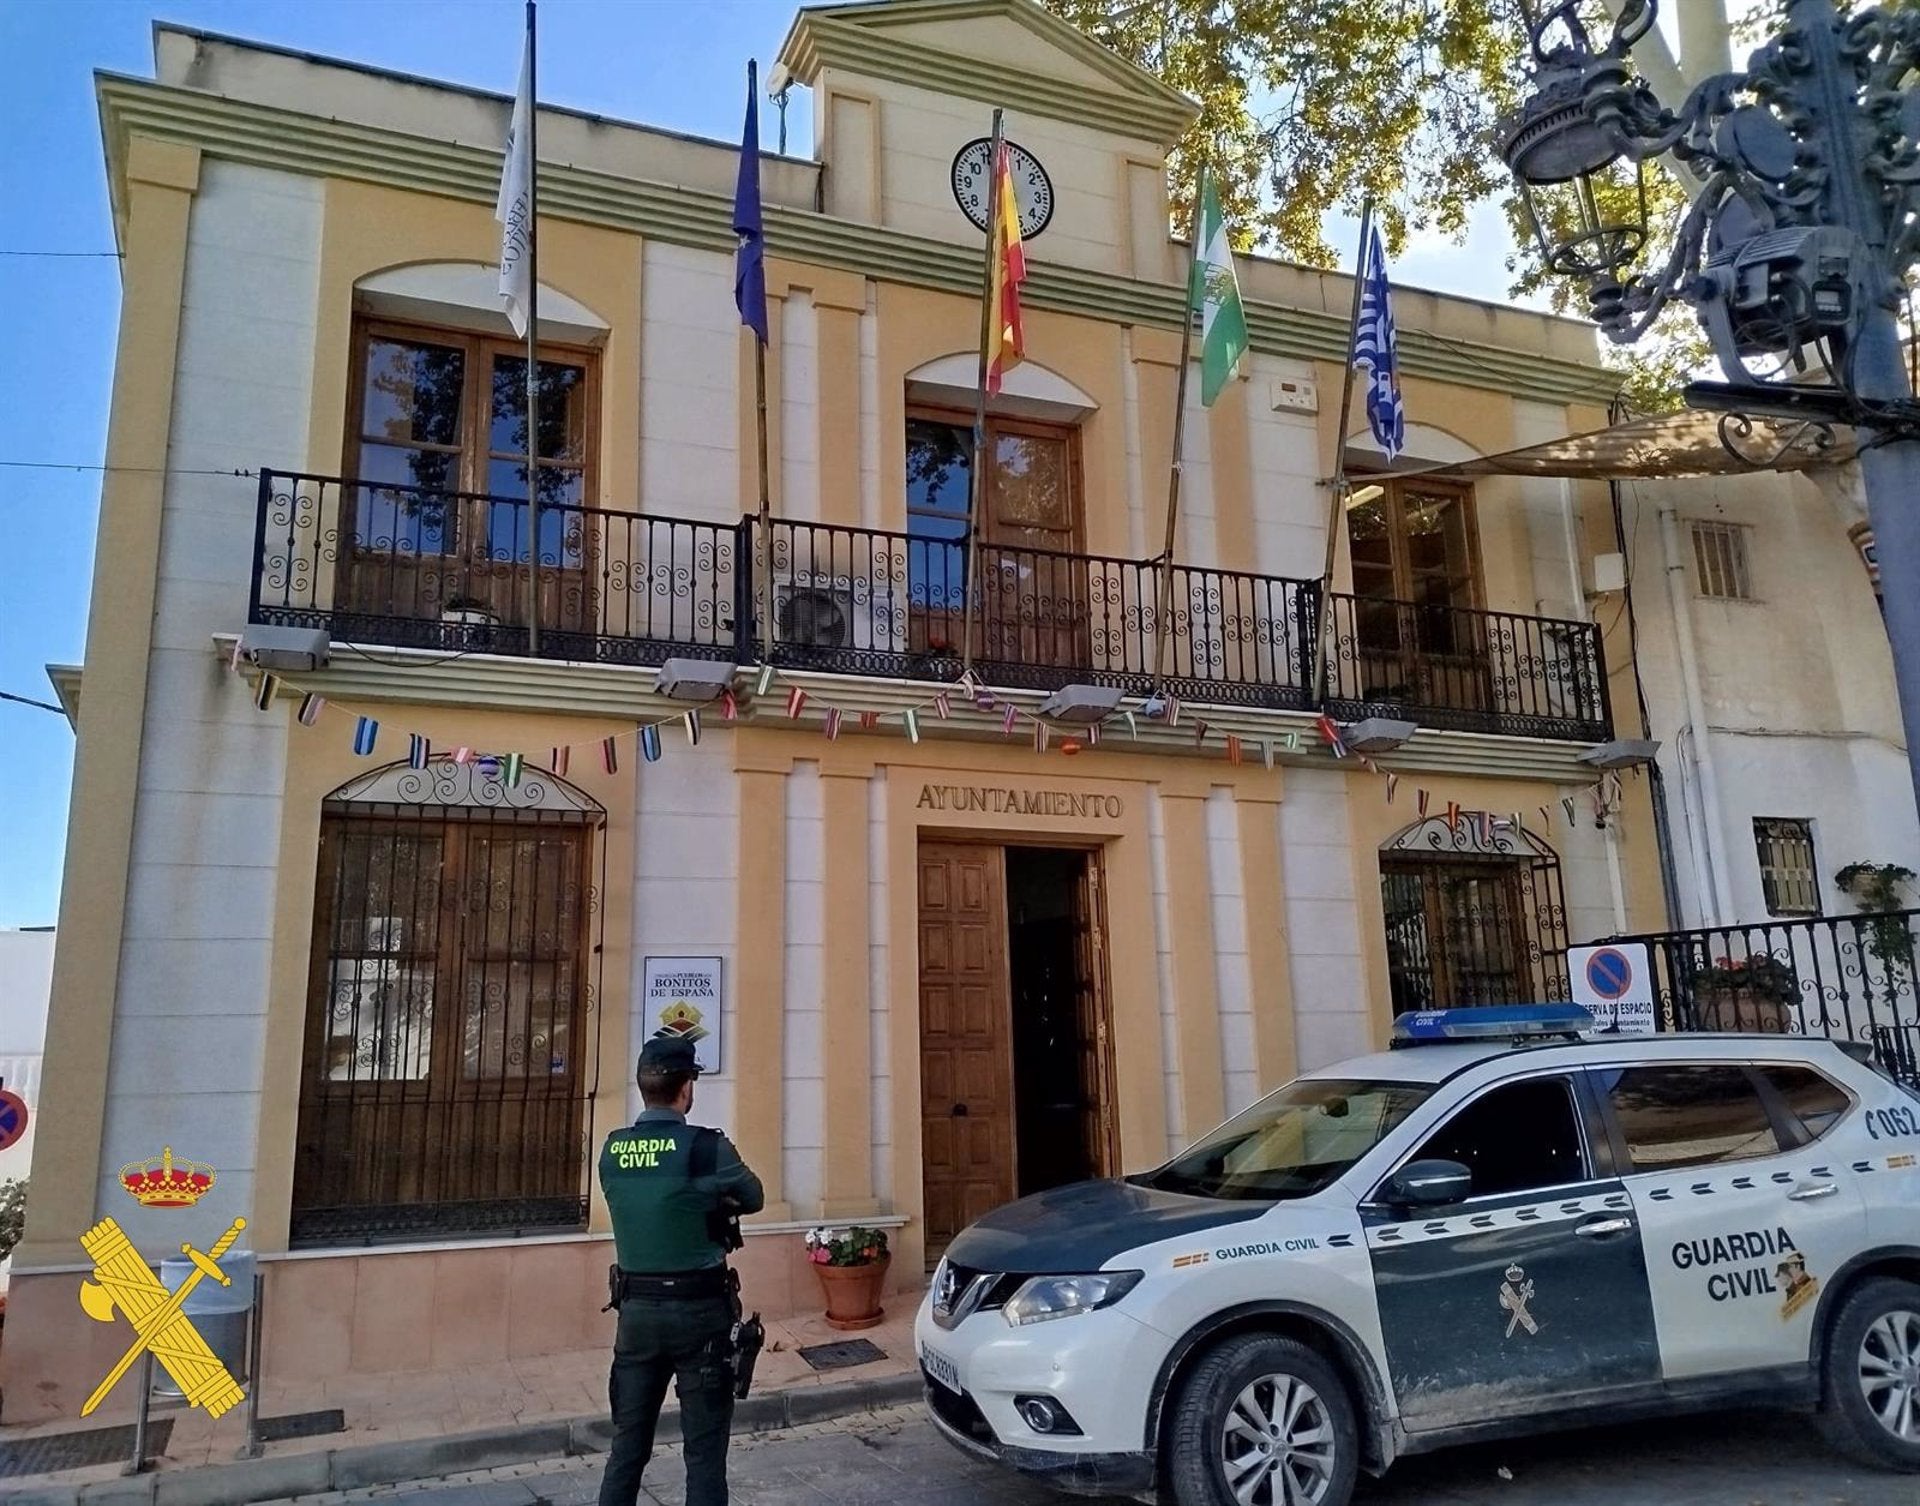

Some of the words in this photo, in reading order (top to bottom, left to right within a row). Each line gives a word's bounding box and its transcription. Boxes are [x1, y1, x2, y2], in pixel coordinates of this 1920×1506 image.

[969, 161, 981, 175] 10
[1016, 160, 1021, 170] 1
[964, 176, 972, 188] 9
[1029, 173, 1036, 185] 2
[970, 194, 979, 207] 8
[1034, 191, 1042, 204] 3
[1029, 207, 1037, 219] 4
[916, 784, 1124, 819] AYUNTAMIENTO
[655, 978, 711, 988] BONITOS
[650, 988, 666, 997] DE
[671, 987, 714, 997] ESPAÑA
[1620, 1002, 1652, 1014] ESPACIO
[1876, 1106, 1920, 1137] 062
[610, 1139, 677, 1154] GUARDIA
[619, 1153, 660, 1168] CIVIL
[1216, 1242, 1282, 1260] GUARDIA
[1285, 1238, 1320, 1252] CIVIL
[1672, 1227, 1796, 1269] GUARDIA
[1708, 1268, 1776, 1301] CIVIL
